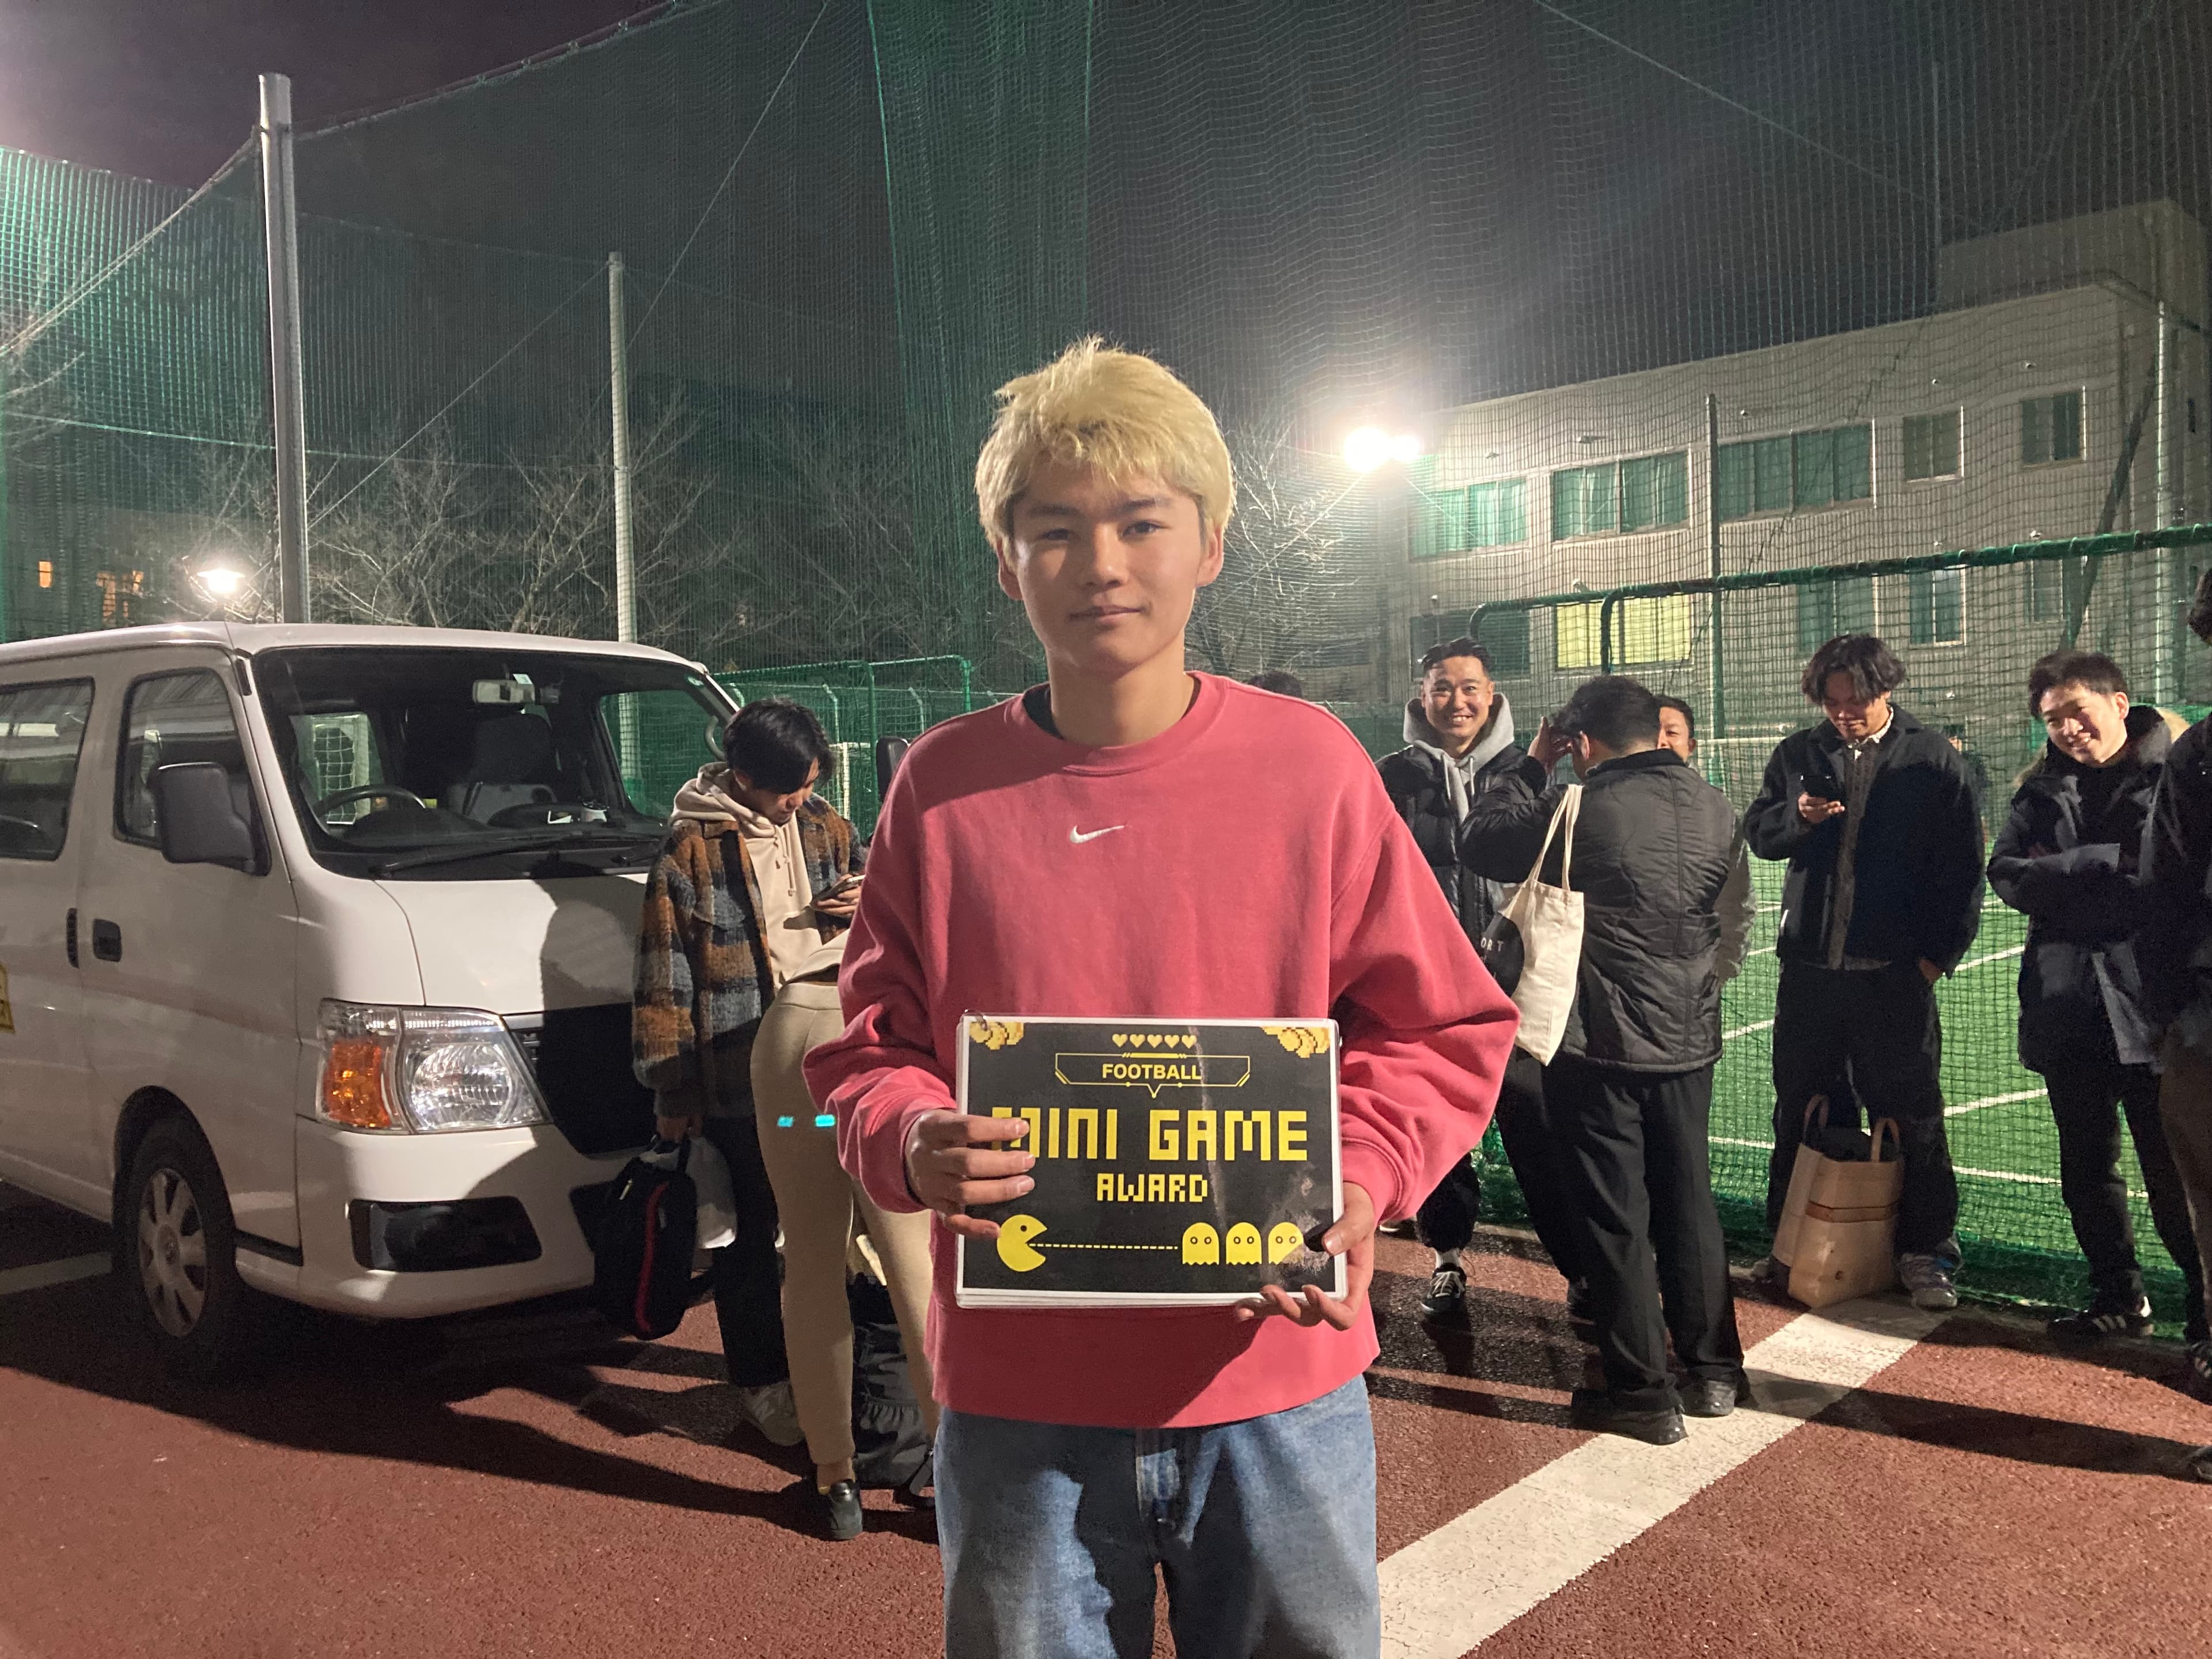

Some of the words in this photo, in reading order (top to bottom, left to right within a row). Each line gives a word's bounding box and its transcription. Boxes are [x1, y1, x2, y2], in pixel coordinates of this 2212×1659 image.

[1102, 1063, 1201, 1080] FOOTBALL
[991, 1107, 1118, 1160] MINI
[1149, 1109, 1307, 1161] GAME
[1097, 1173, 1208, 1202] AWARD
